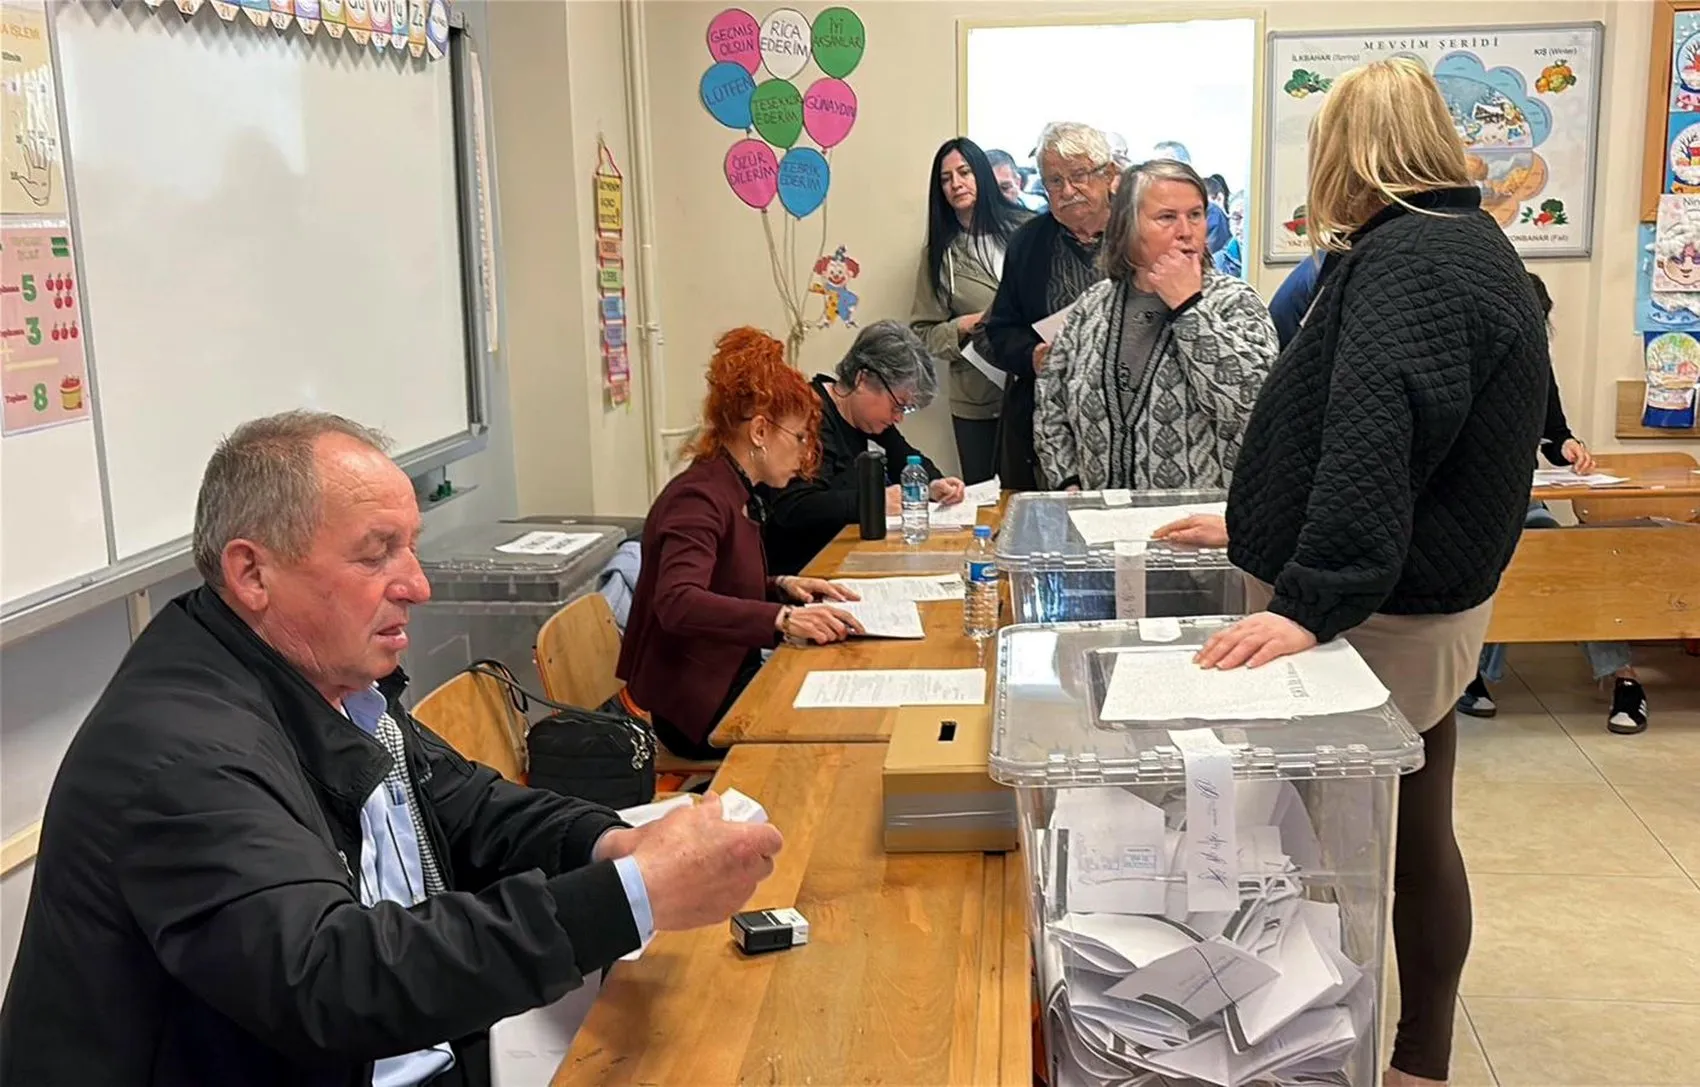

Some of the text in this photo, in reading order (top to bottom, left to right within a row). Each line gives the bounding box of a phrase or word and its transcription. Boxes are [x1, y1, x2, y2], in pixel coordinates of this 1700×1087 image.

[770, 19, 802, 41] RİCA
[760, 36, 809, 58] EDERİM
[1363, 37, 1498, 50] MEVSİM ŞERİDİ
[1549, 47, 1577, 56] (Winter)
[22, 274, 37, 301] 5
[25, 317, 42, 345] 3
[33, 383, 48, 411] 8
